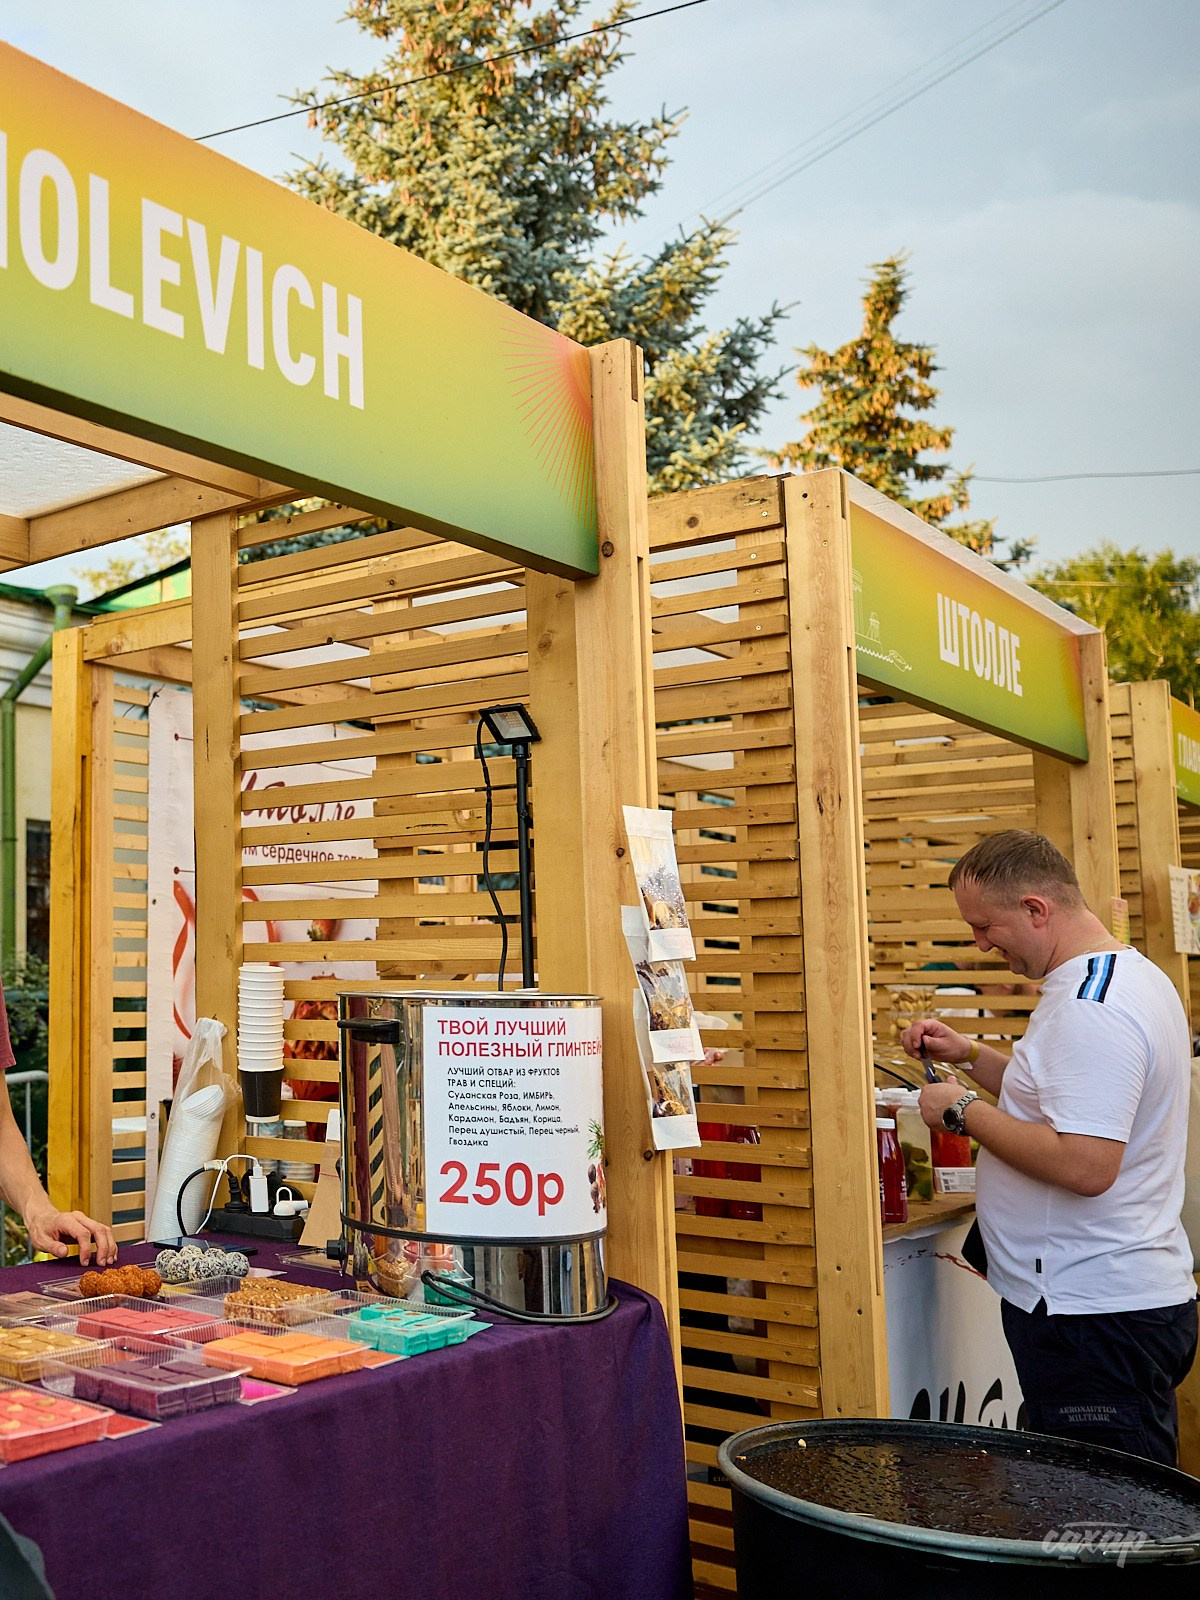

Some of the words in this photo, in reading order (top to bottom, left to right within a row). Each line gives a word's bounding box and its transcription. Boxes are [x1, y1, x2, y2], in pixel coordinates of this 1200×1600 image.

[937, 592, 1023, 697] ШТОЛЛЕ
[437, 1016, 488, 1035] ТВОЙ
[494, 1016, 567, 1036] ЛУЧШИЙ
[438, 1038, 543, 1058] ПОЛЕЗНЫЙ
[447, 1066, 485, 1076] ЛУЧШИЙ
[487, 1067, 514, 1076] ОТВАР
[516, 1068, 526, 1077] ИЗ
[528, 1067, 560, 1076] ФРУКТОВ
[447, 1078, 468, 1087] ТРАВ
[470, 1079, 476, 1087] И
[479, 1078, 516, 1089] СПЕЦИЙ:
[448, 1090, 497, 1100] Суданская
[499, 1091, 521, 1101] Роза,
[523, 1091, 555, 1100] ИМБИРЬ,
[448, 1102, 500, 1112] Апельсины,
[502, 1103, 533, 1112] Яблоки,
[535, 1103, 561, 1112] Лимон,
[448, 1113, 497, 1124] Кардамон,
[533, 1115, 562, 1124] Корица,
[448, 1125, 478, 1135] Перец
[480, 1126, 526, 1137] душистый,
[529, 1127, 553, 1137] Перец
[449, 1137, 489, 1147] Гвоздика
[439, 1160, 565, 1216] 250р
[1059, 1405, 1117, 1414] AERONAUTICA
[1068, 1413, 1110, 1422] MILITARE
